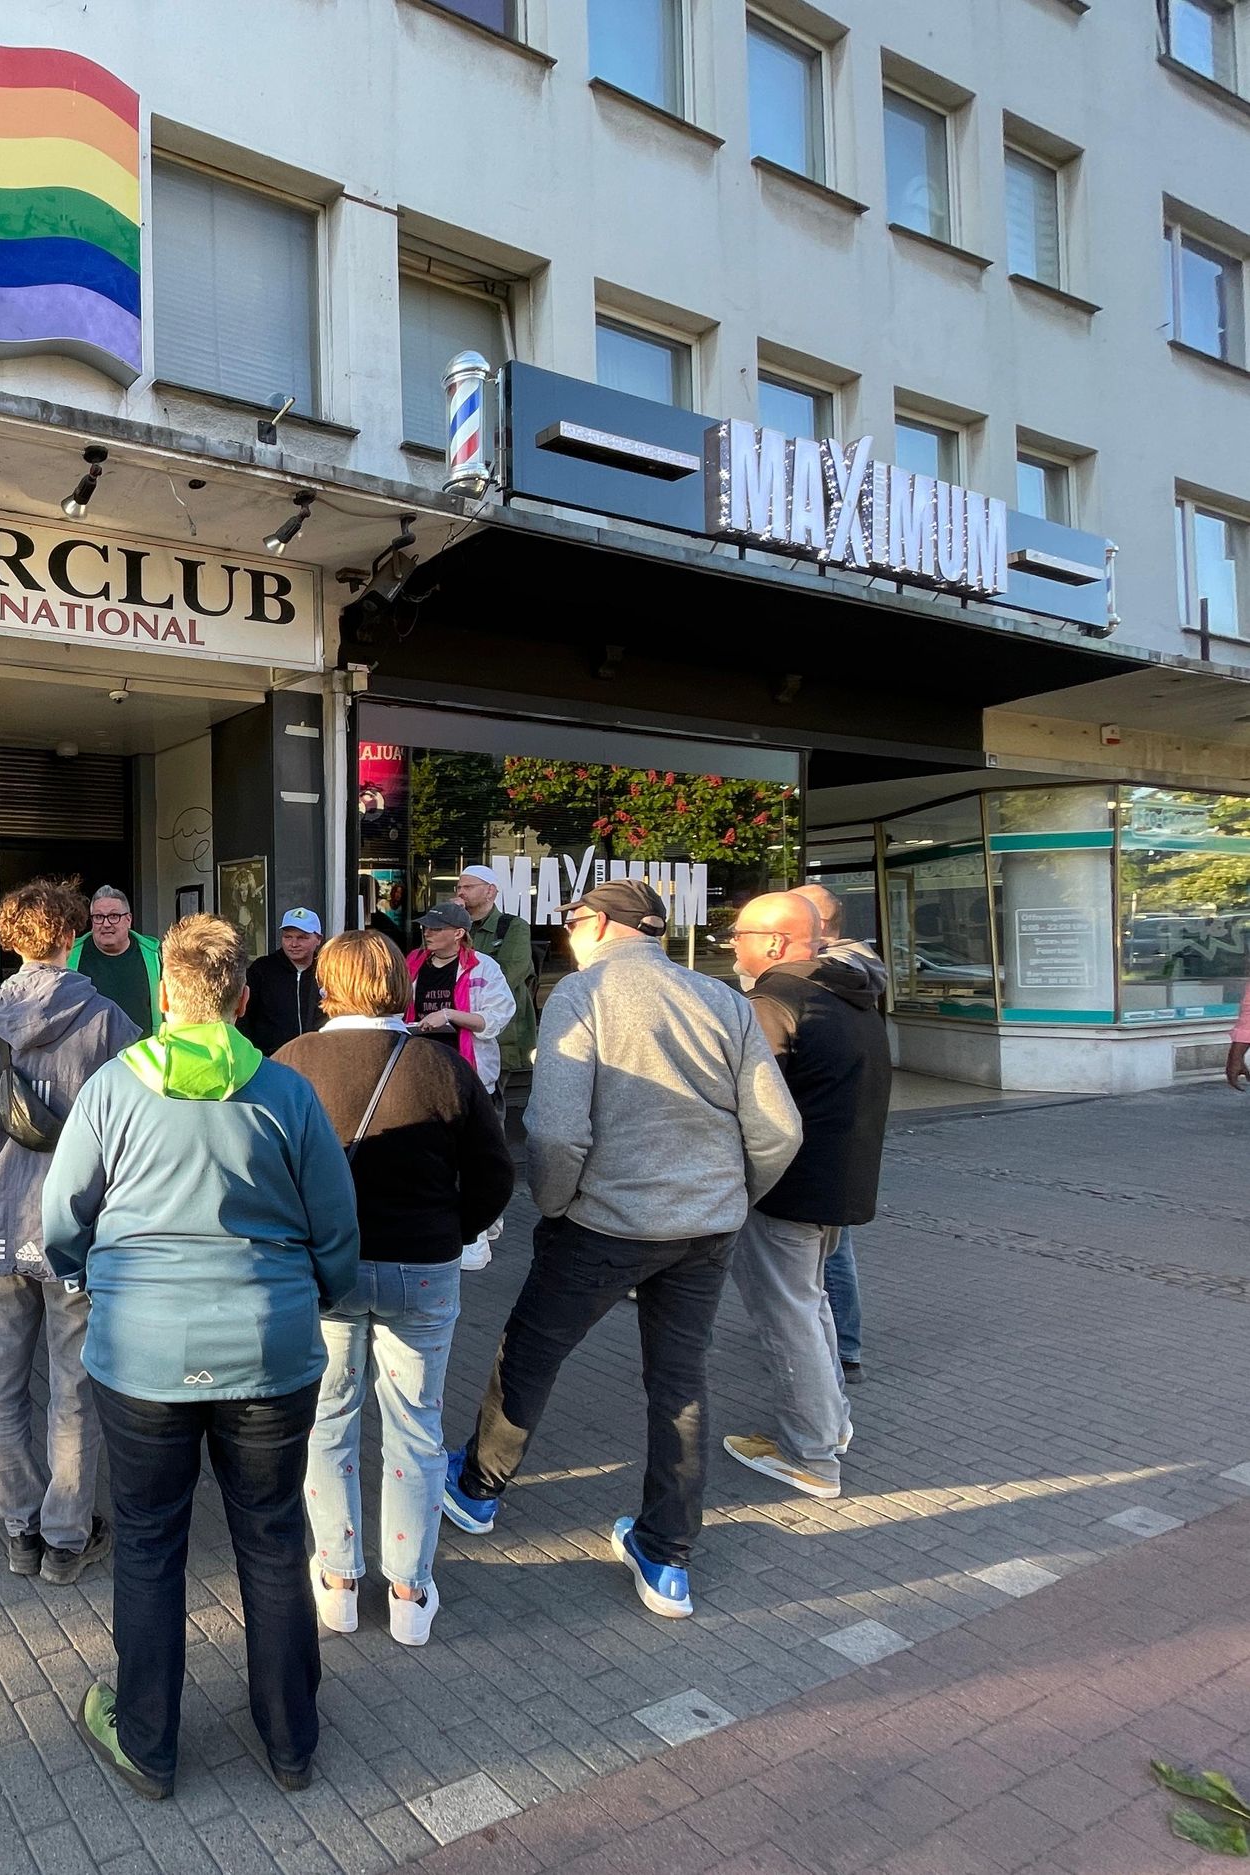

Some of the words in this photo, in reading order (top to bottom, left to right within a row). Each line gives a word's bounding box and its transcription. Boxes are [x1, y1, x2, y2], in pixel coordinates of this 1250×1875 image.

[727, 418, 1007, 593] MAXIMUM
[596, 864, 604, 886] HAA
[15, 1252, 44, 1263] adidas
